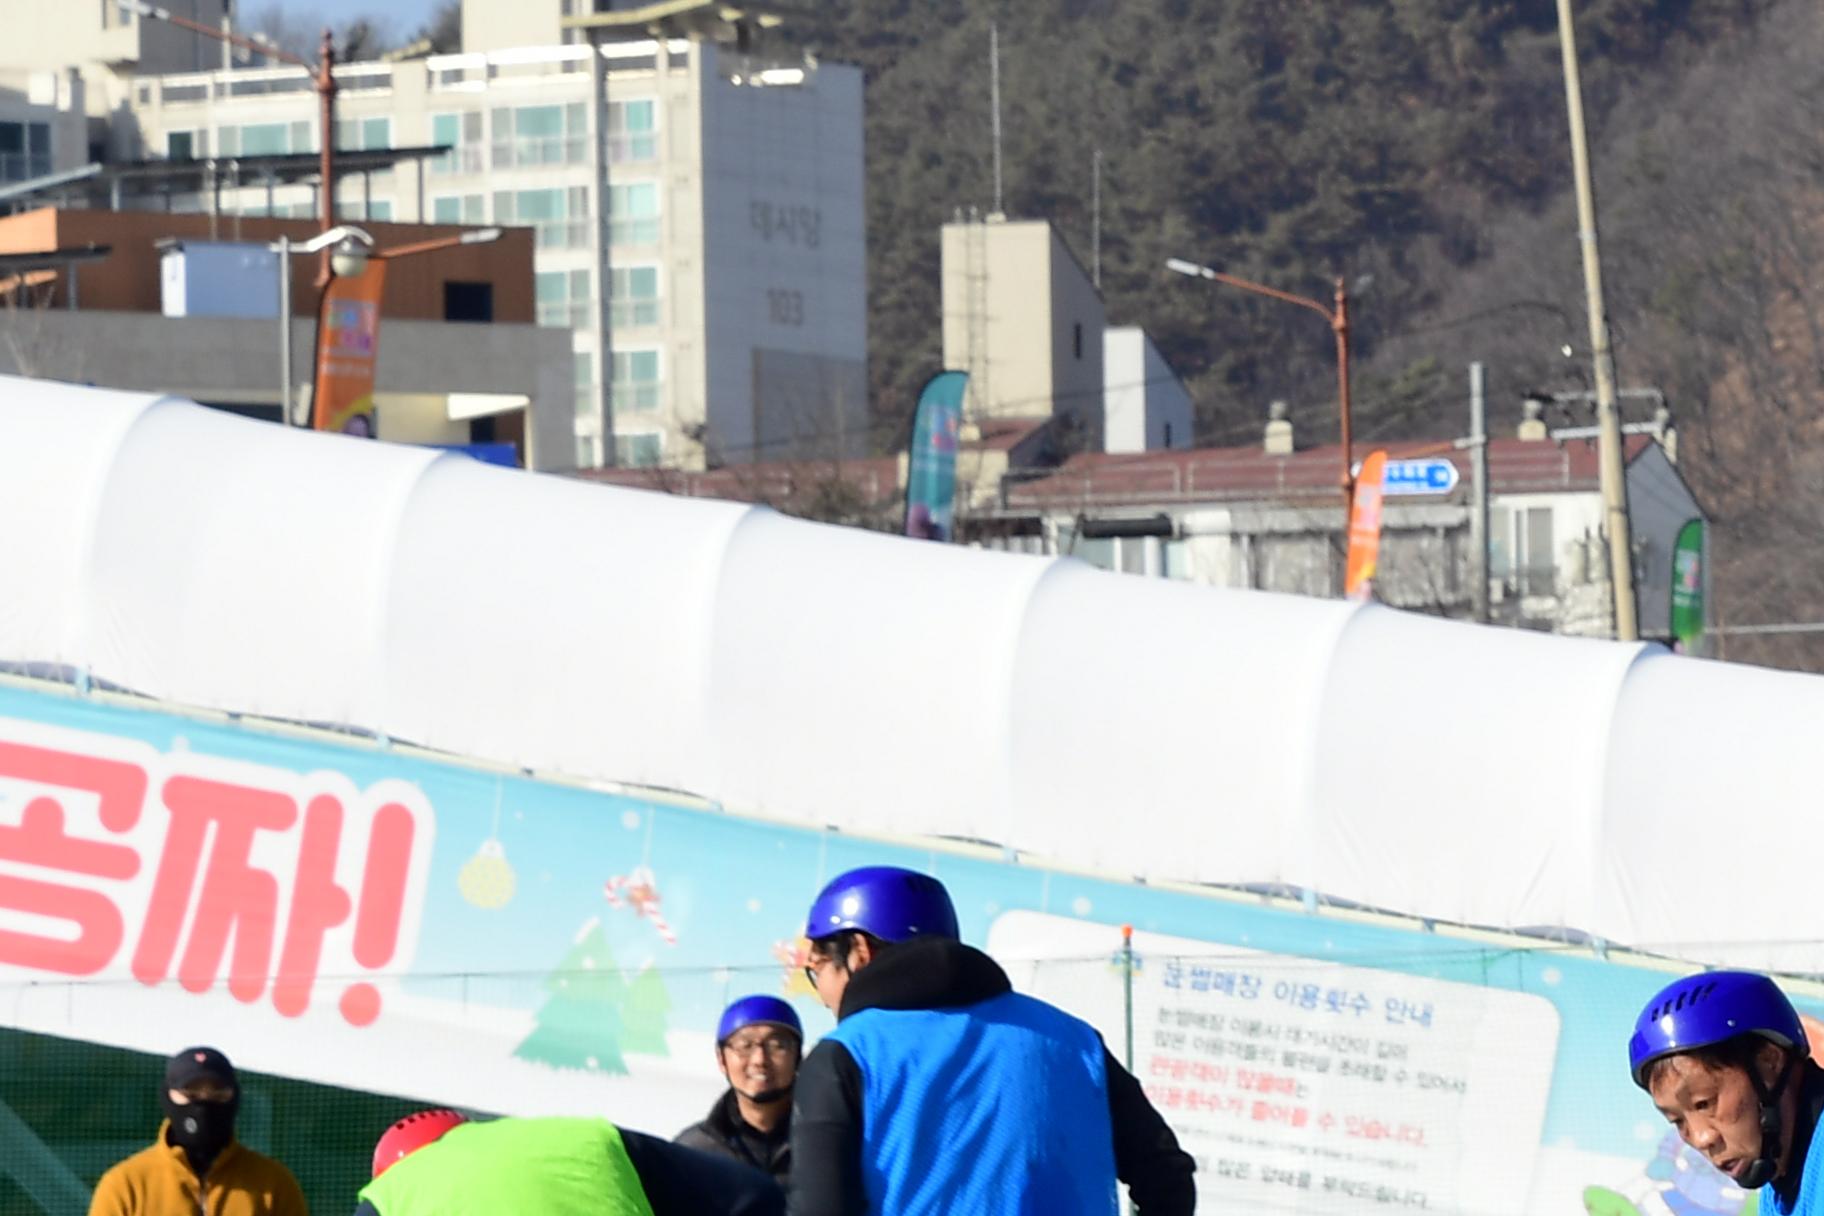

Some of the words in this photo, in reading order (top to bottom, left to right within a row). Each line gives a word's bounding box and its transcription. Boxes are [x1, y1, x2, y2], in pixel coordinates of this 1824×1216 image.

[767, 287, 803, 326] 103
[1163, 960, 1263, 999] 눈썰매장
[1274, 979, 1371, 1017] 이용횟수
[1385, 997, 1434, 1028] 안내
